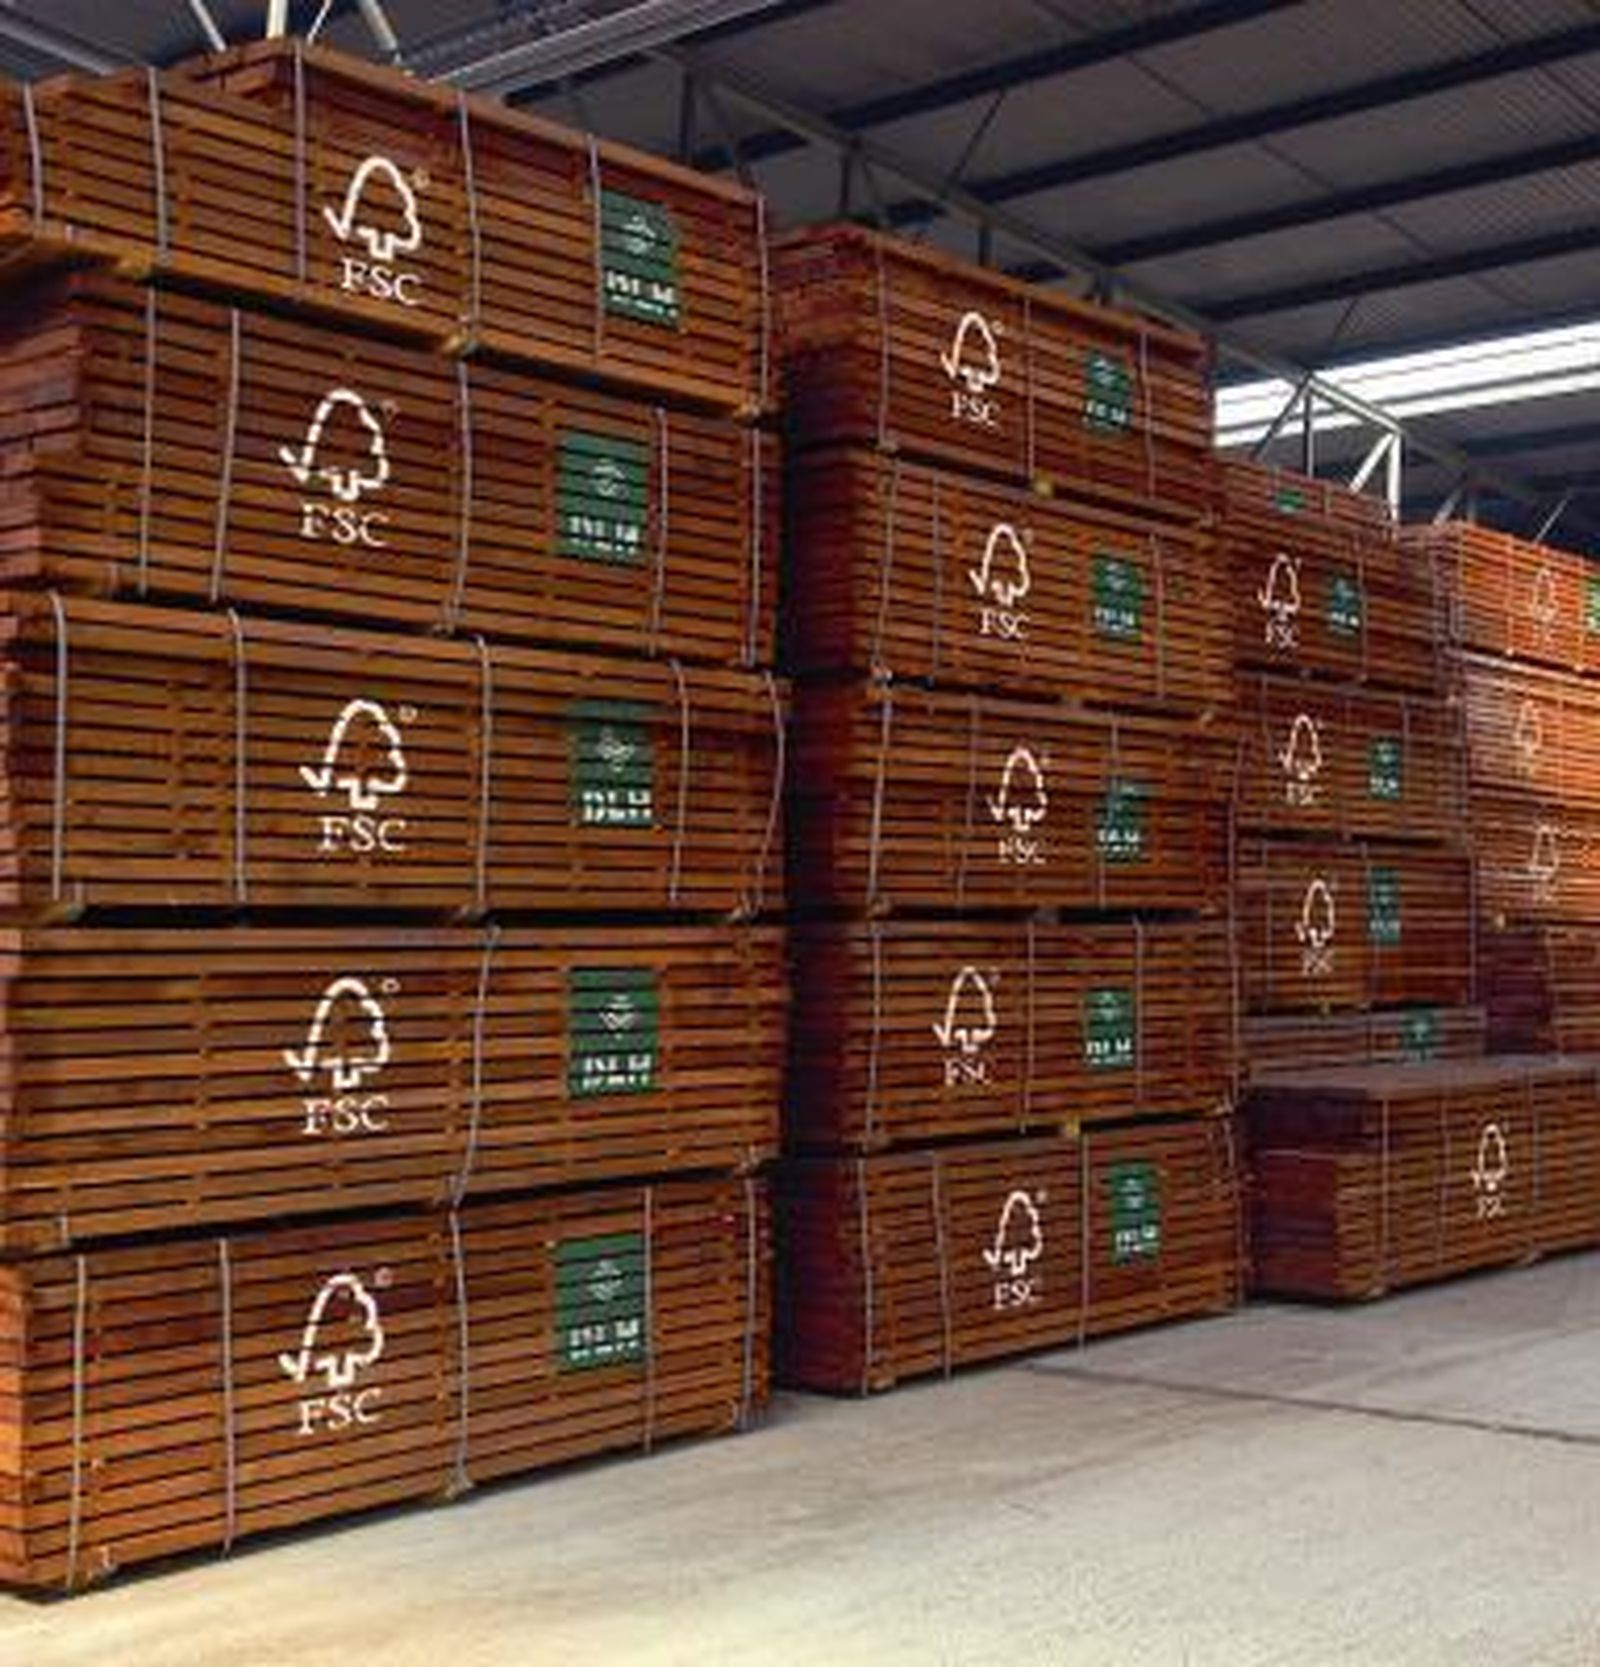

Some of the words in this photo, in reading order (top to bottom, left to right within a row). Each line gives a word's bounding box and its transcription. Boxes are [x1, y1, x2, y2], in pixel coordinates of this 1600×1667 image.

[341, 257, 421, 305] FSC
[950, 391, 1001, 427] FSC
[300, 503, 390, 547] FSC
[980, 607, 1030, 640] FSC
[320, 815, 405, 851] FSC
[301, 1095, 388, 1135] FSC
[298, 1388, 380, 1435] FSC
